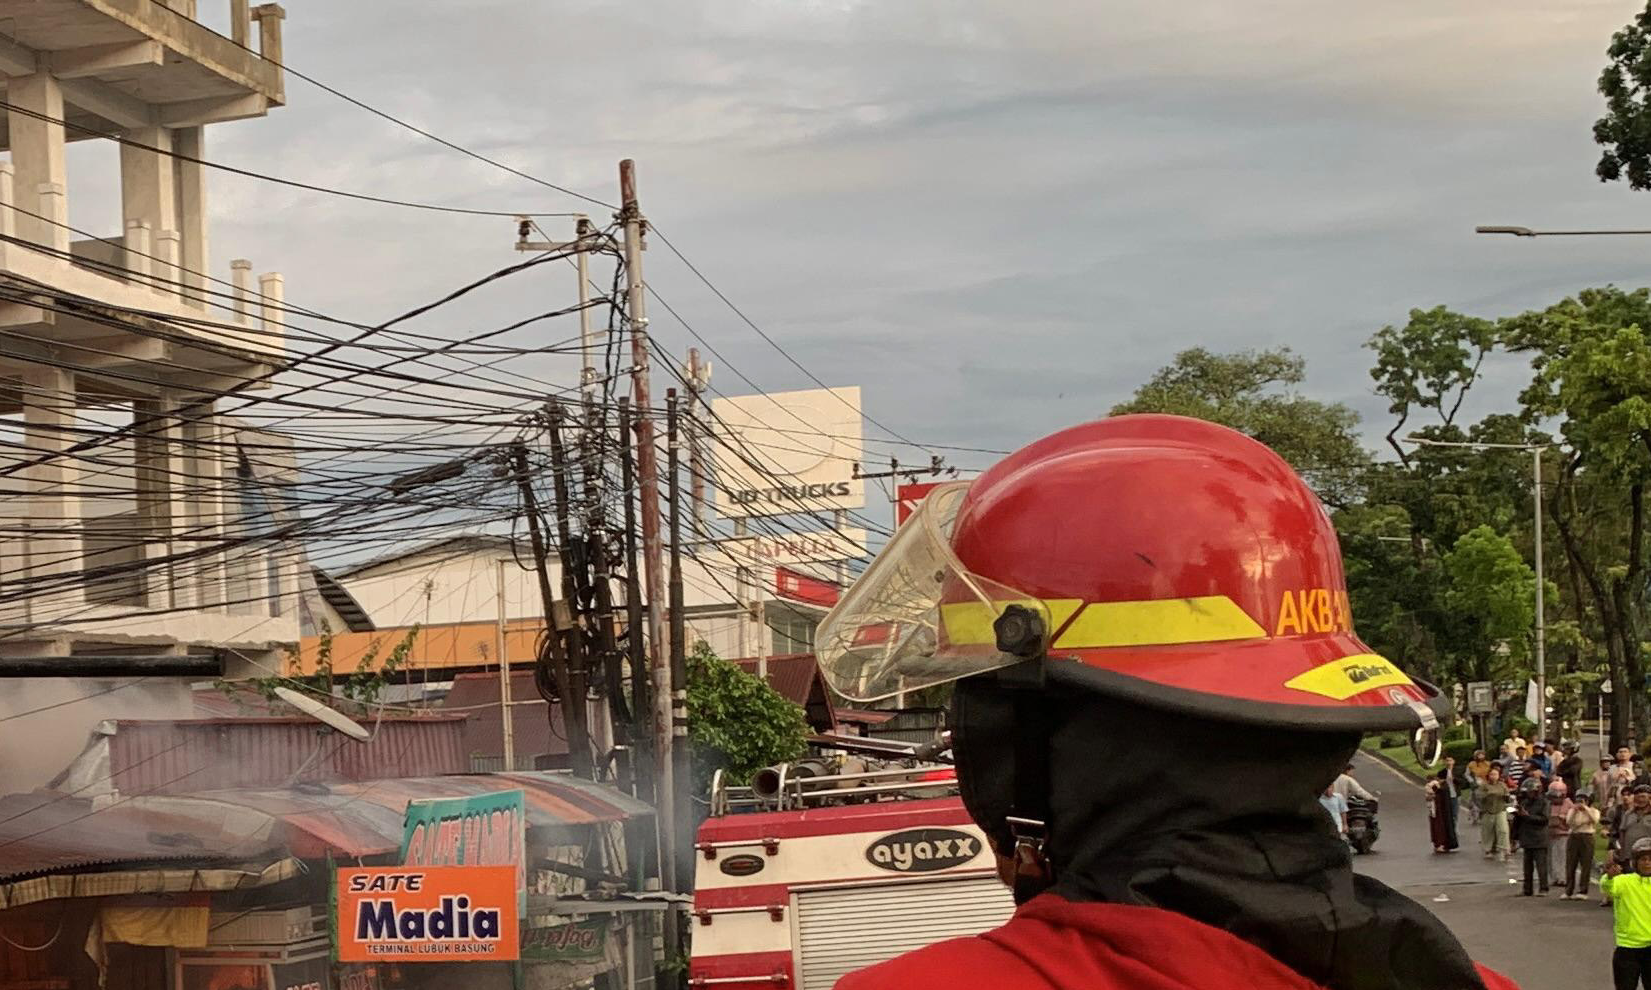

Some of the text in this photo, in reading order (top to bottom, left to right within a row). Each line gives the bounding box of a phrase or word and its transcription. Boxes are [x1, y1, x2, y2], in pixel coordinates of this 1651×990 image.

[763, 482, 850, 501] TRUCKS
[872, 838, 975, 870] ayaxx
[349, 874, 424, 892] SATE
[356, 896, 499, 940] Madia
[367, 943, 495, 954] TERMINAL LUBUK BASUNG
